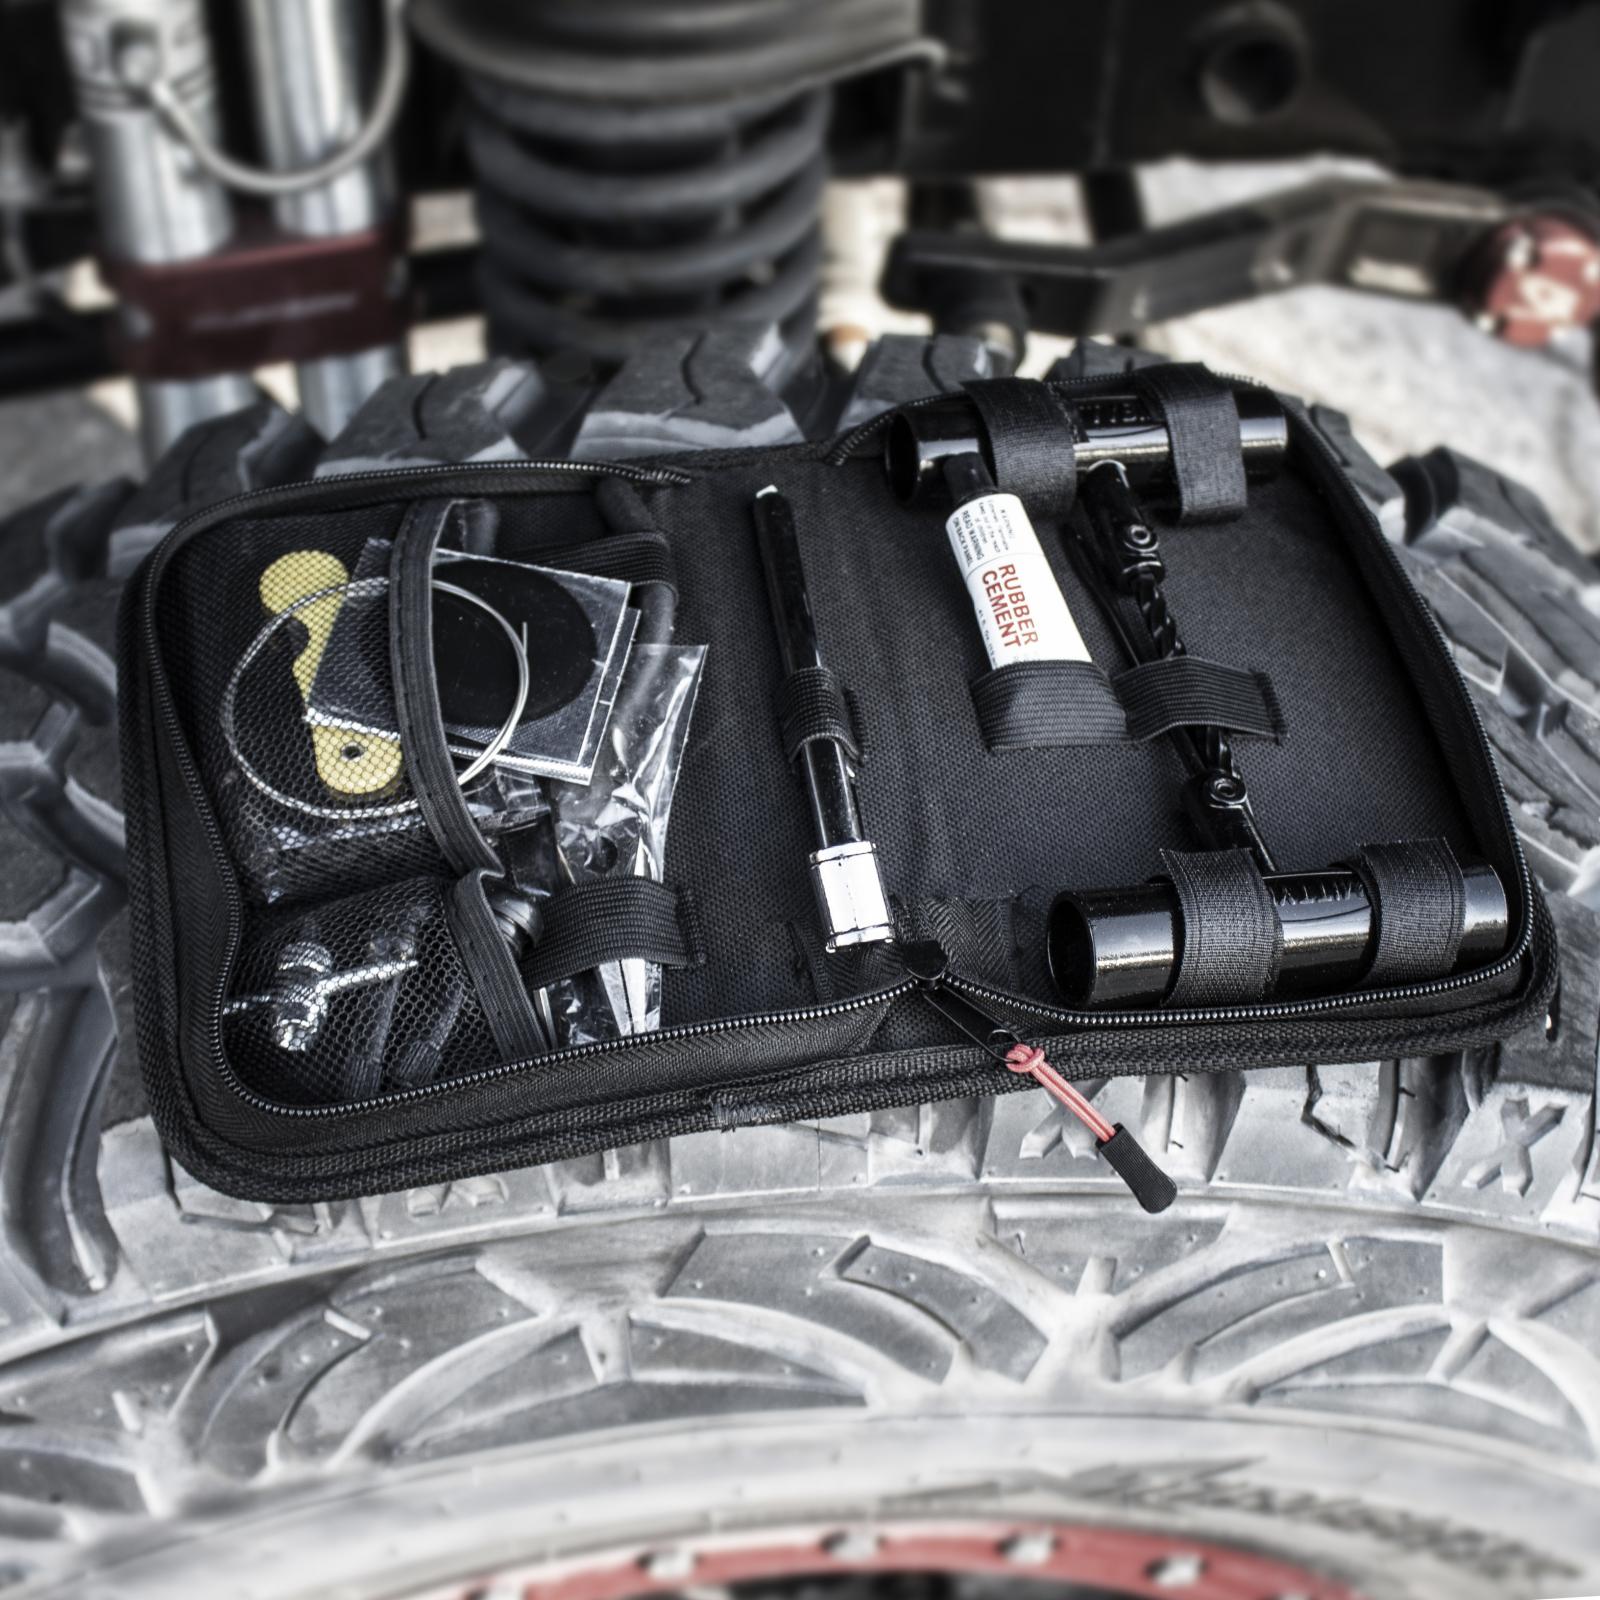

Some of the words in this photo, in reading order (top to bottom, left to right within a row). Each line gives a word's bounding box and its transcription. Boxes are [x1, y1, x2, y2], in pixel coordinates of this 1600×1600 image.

[962, 510, 974, 529] READ
[968, 528, 984, 560] WARNING
[982, 570, 1021, 647] CEMENT
[999, 563, 1039, 645] RUBBER
